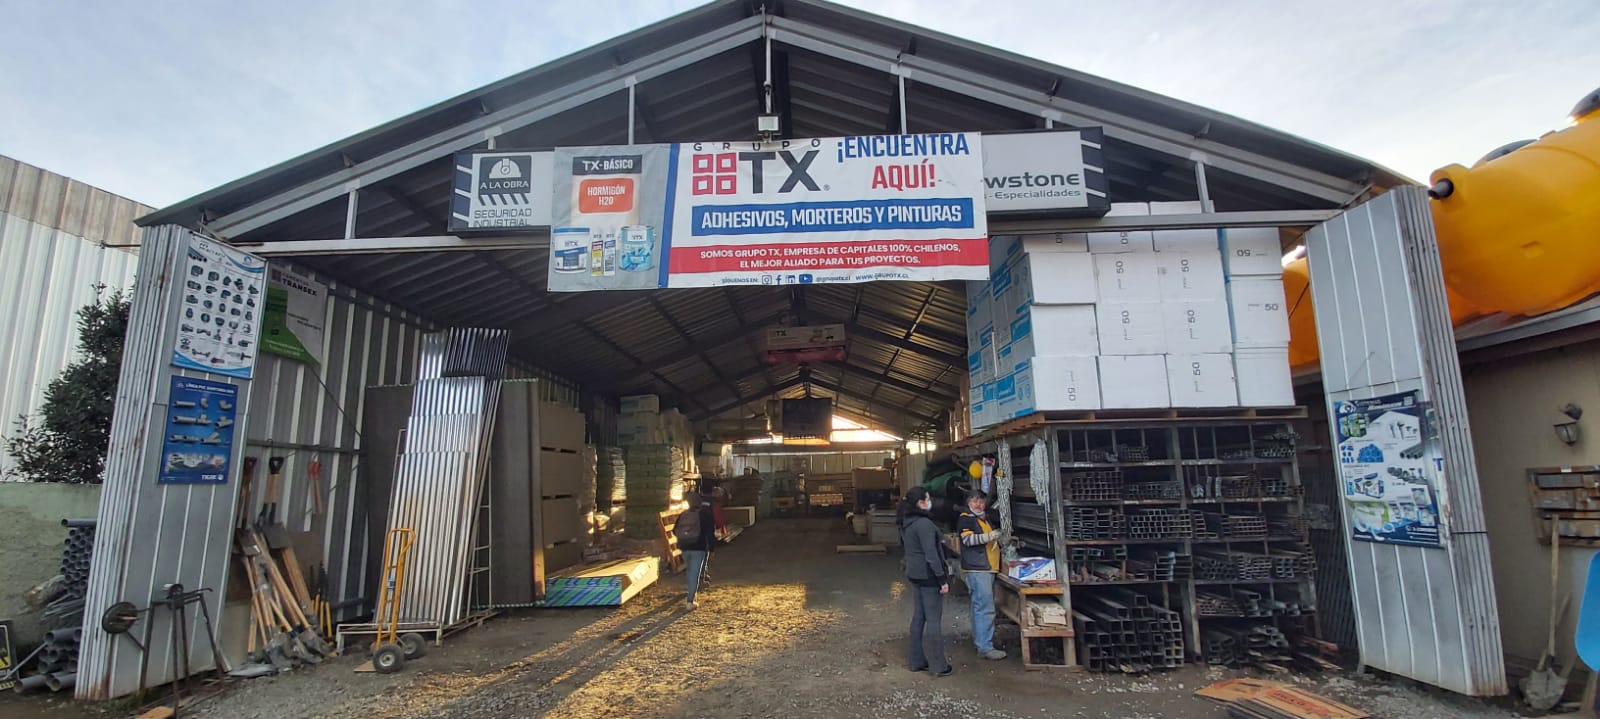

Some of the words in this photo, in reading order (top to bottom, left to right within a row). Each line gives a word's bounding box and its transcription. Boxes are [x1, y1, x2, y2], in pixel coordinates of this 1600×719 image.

[837, 133, 970, 163] ¡ENCUENTRA
[582, 159, 633, 171] TX-BÁSICO
[871, 158, 936, 191] AQUÍ!
[480, 182, 487, 190] A
[489, 181, 501, 189] LA
[503, 180, 529, 189] OBRA
[587, 184, 626, 196] HORMIGÓN
[994, 189, 1081, 200] Especialidades
[474, 208, 532, 219] SEGURIDAD
[701, 210, 788, 229] ADHESIVOS,
[791, 207, 873, 226] MORTEROS
[874, 206, 885, 223] Y
[887, 205, 962, 223] PINTURAS
[700, 251, 734, 259] SOMOS
[735, 249, 767, 258] GRUPO
[768, 248, 782, 257] TX,
[784, 246, 826, 256] EMPRESA
[827, 247, 839, 255] DE
[840, 244, 889, 253] CAPITALES
[890, 244, 913, 252] 100%
[914, 243, 961, 253] CHILENOS,
[751, 259, 782, 268] MEJOR
[783, 258, 818, 266] ALIADO
[846, 257, 863, 265] TUS
[864, 255, 921, 264] PROYECTOS.
[282, 278, 318, 296] TRANSEX
